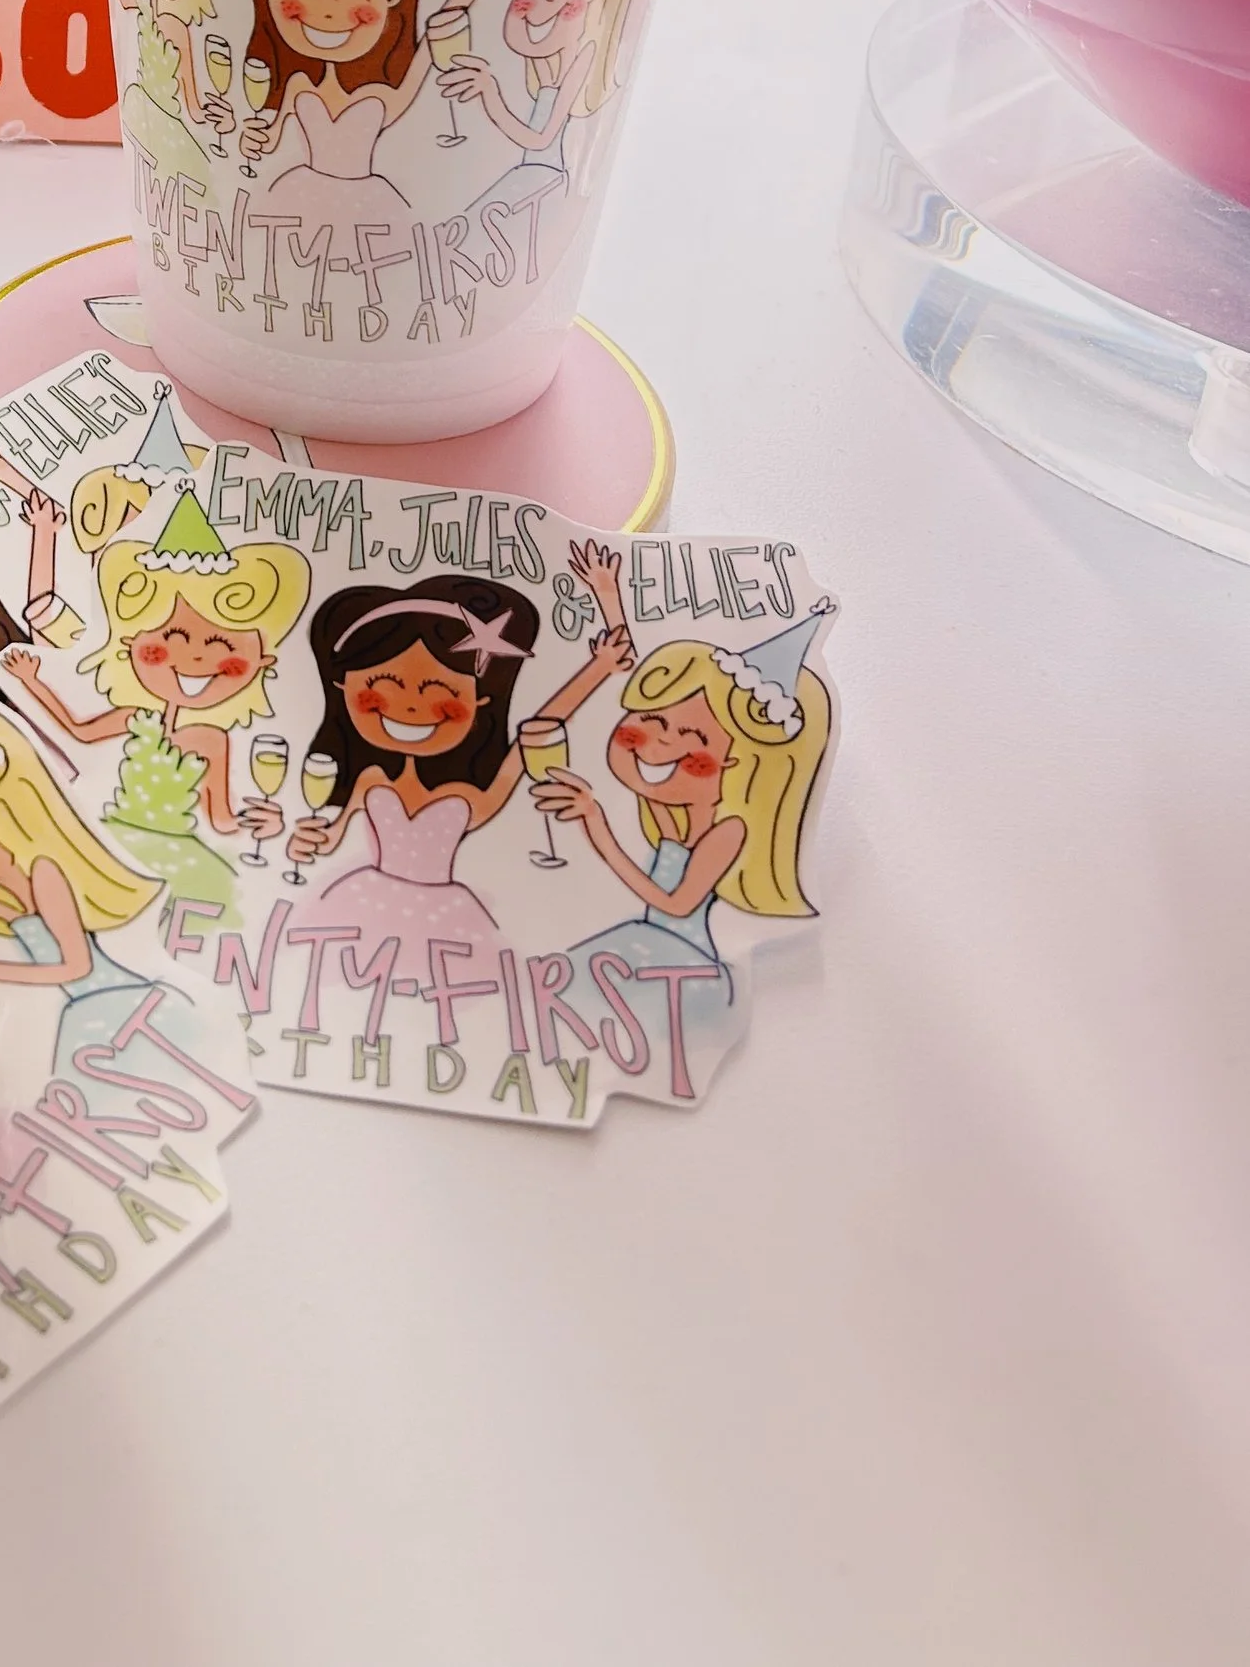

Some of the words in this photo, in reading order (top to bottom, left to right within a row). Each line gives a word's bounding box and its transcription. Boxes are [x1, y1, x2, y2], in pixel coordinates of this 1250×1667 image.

[123, 121, 564, 307] TWENTY-FIRST
[152, 232, 476, 344] BIRTHDAY
[207, 445, 385, 571] EMMA,
[552, 573, 596, 641] &
[628, 539, 798, 622] ELLIE'S
[159, 896, 721, 1100] ENTY-FIRST
